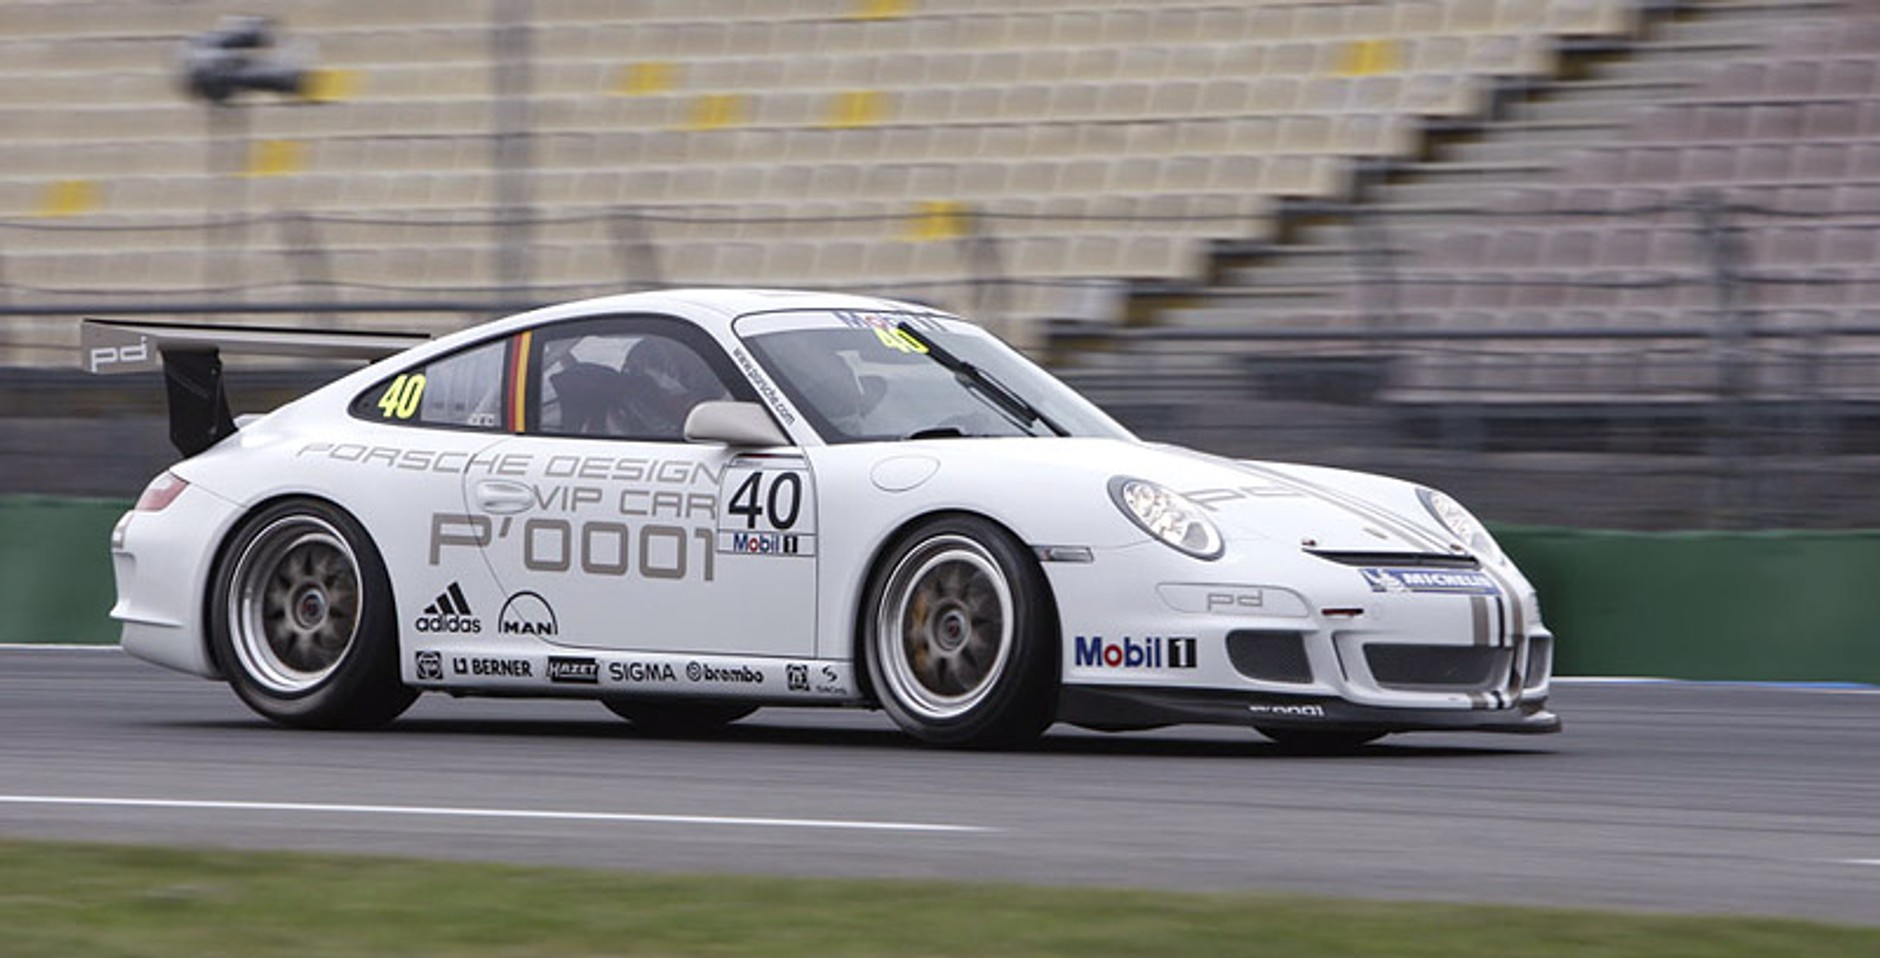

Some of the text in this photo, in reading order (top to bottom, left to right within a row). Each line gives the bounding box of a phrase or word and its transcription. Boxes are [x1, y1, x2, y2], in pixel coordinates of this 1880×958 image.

[91, 335, 147, 373] pd
[378, 373, 427, 419] 40
[297, 442, 720, 484] PORSCHE DESIGN
[533, 484, 717, 520] VIP CAR
[728, 471, 801, 530] 40
[733, 533, 779, 554] Mobil
[1207, 590, 1263, 612] pd
[415, 615, 482, 633] adidas
[503, 622, 551, 635] MAN
[1074, 636, 1194, 668] Mobil 1
[472, 659, 533, 677] BERNER
[608, 662, 677, 682] SIGMA
